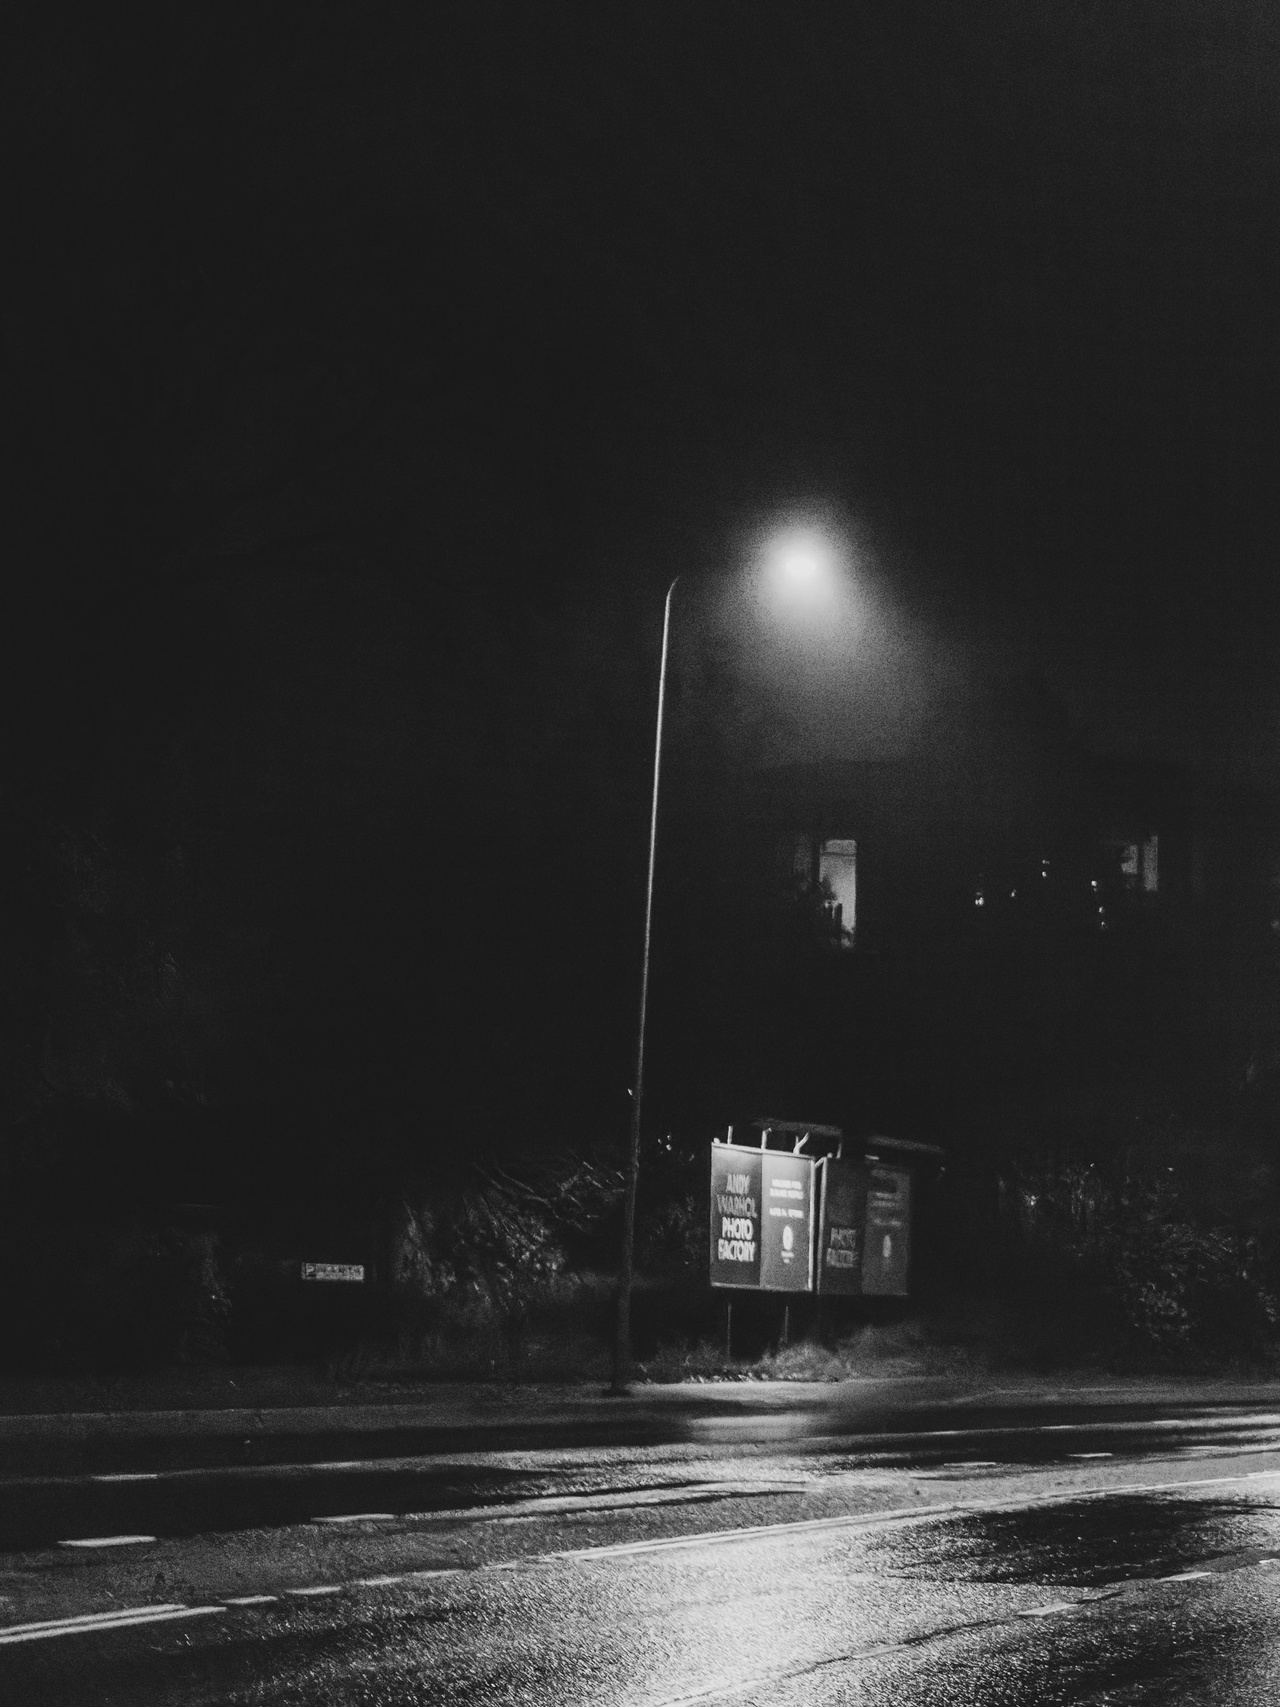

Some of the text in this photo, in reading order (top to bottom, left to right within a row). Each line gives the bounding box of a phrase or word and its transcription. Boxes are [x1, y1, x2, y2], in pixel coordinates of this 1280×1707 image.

[725, 1173, 751, 1195] ANDY
[716, 1194, 758, 1219] WARHOL
[722, 1216, 754, 1240] PHOTO
[718, 1238, 756, 1262] FACTORY
